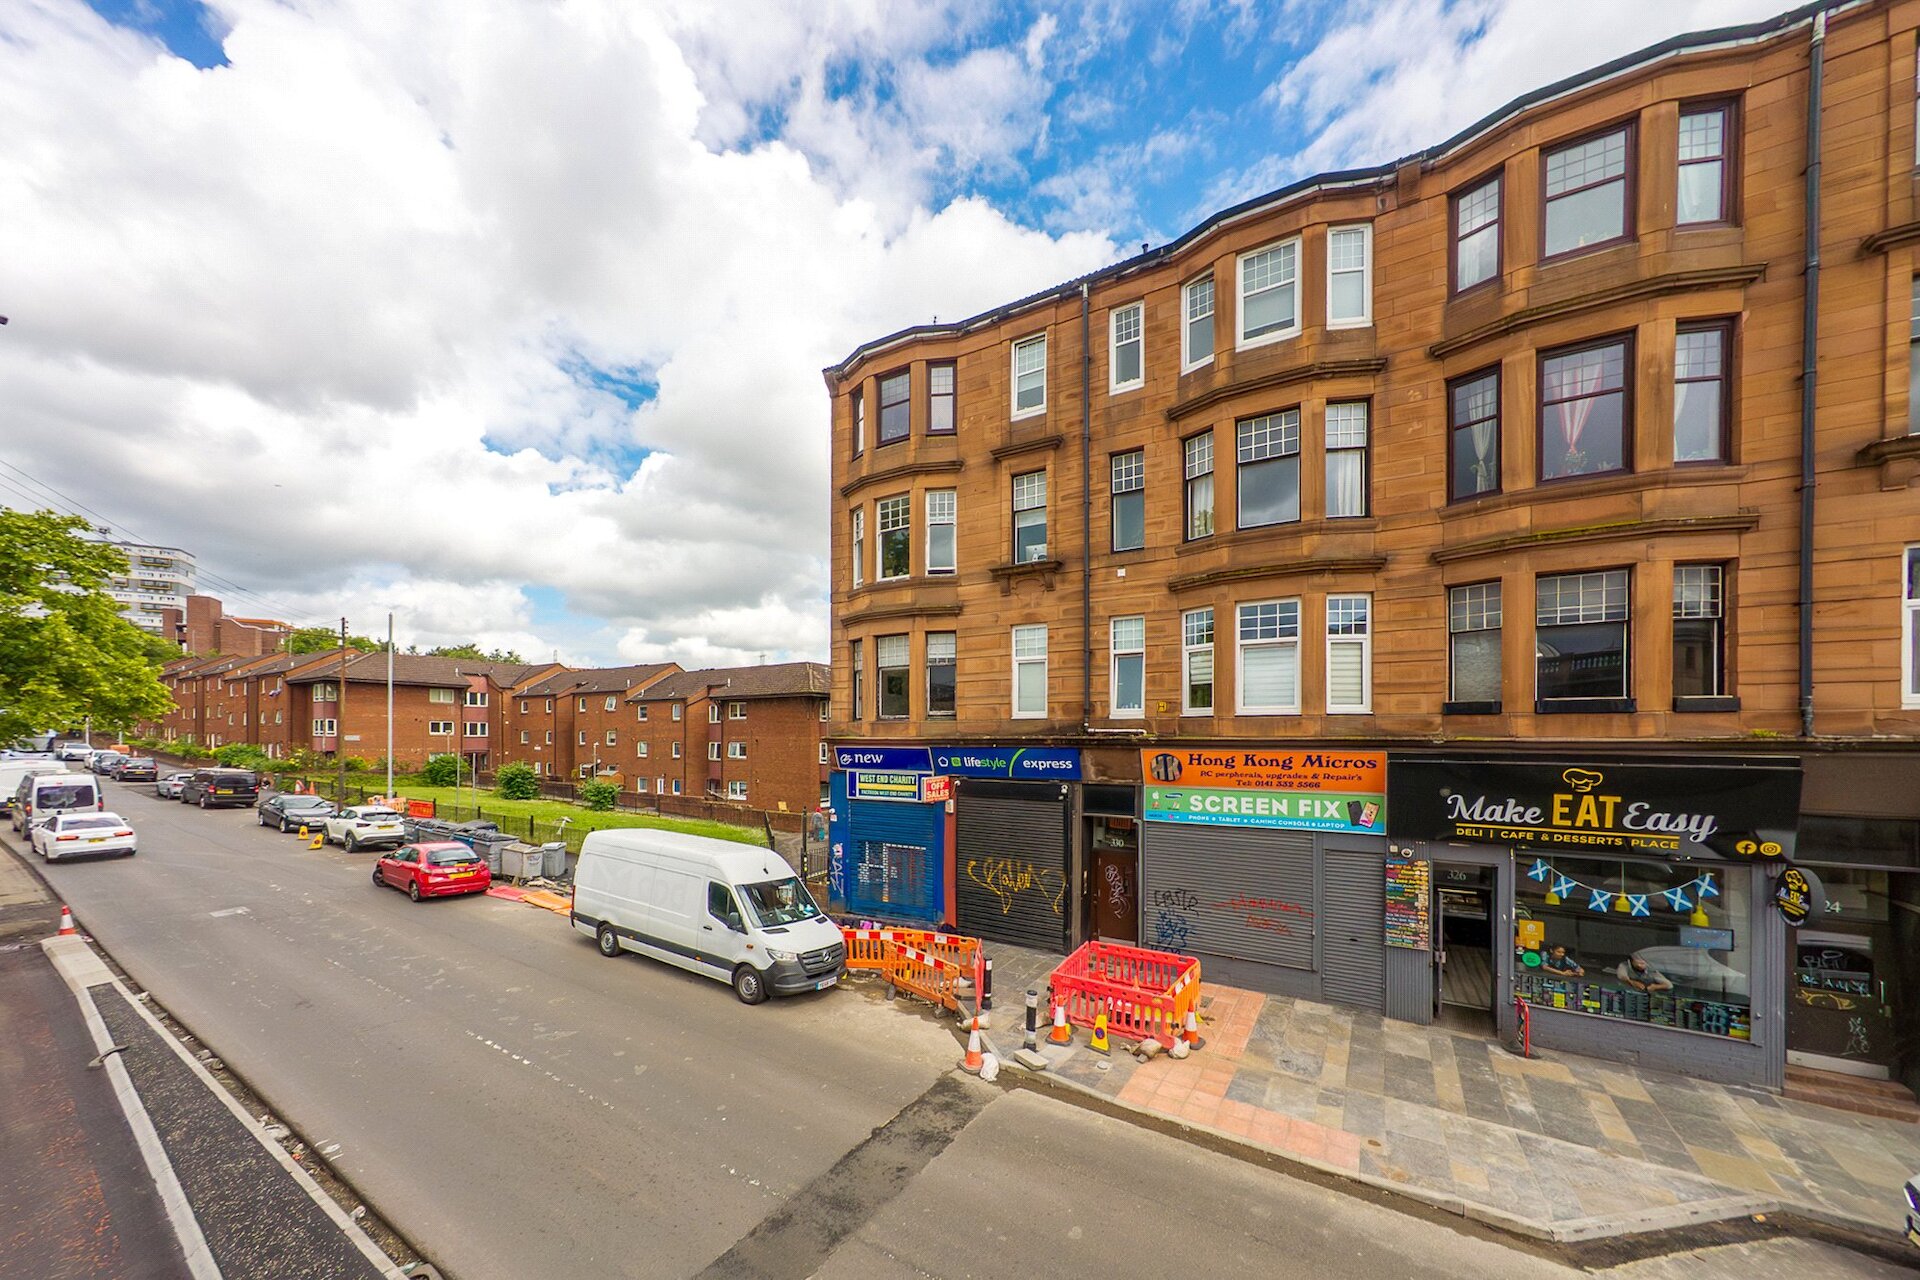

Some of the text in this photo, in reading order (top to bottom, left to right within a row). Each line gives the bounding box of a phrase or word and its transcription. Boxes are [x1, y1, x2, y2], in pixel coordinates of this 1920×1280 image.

[854, 753, 884, 764] new
[963, 756, 1073, 771] lifestyle express
[1188, 753, 1377, 771] Hong Kong Micros
[860, 774, 916, 784] WEST END CHARITY
[930, 782, 945, 791] OFF
[927, 789, 949, 799] SALES
[1189, 794, 1342, 818] SCREEN FIX
[1446, 793, 1719, 843] Make EAT Easy
[1317, 821, 1345, 829] LAPTOP
[1109, 838, 1125, 848] 330
[1455, 828, 1483, 838] DELI
[1500, 829, 1535, 841] CAFE
[1540, 832, 1550, 842] &
[1553, 833, 1623, 846] DESSERTS
[1631, 839, 1680, 850] PLACE
[1447, 869, 1467, 881] 326
